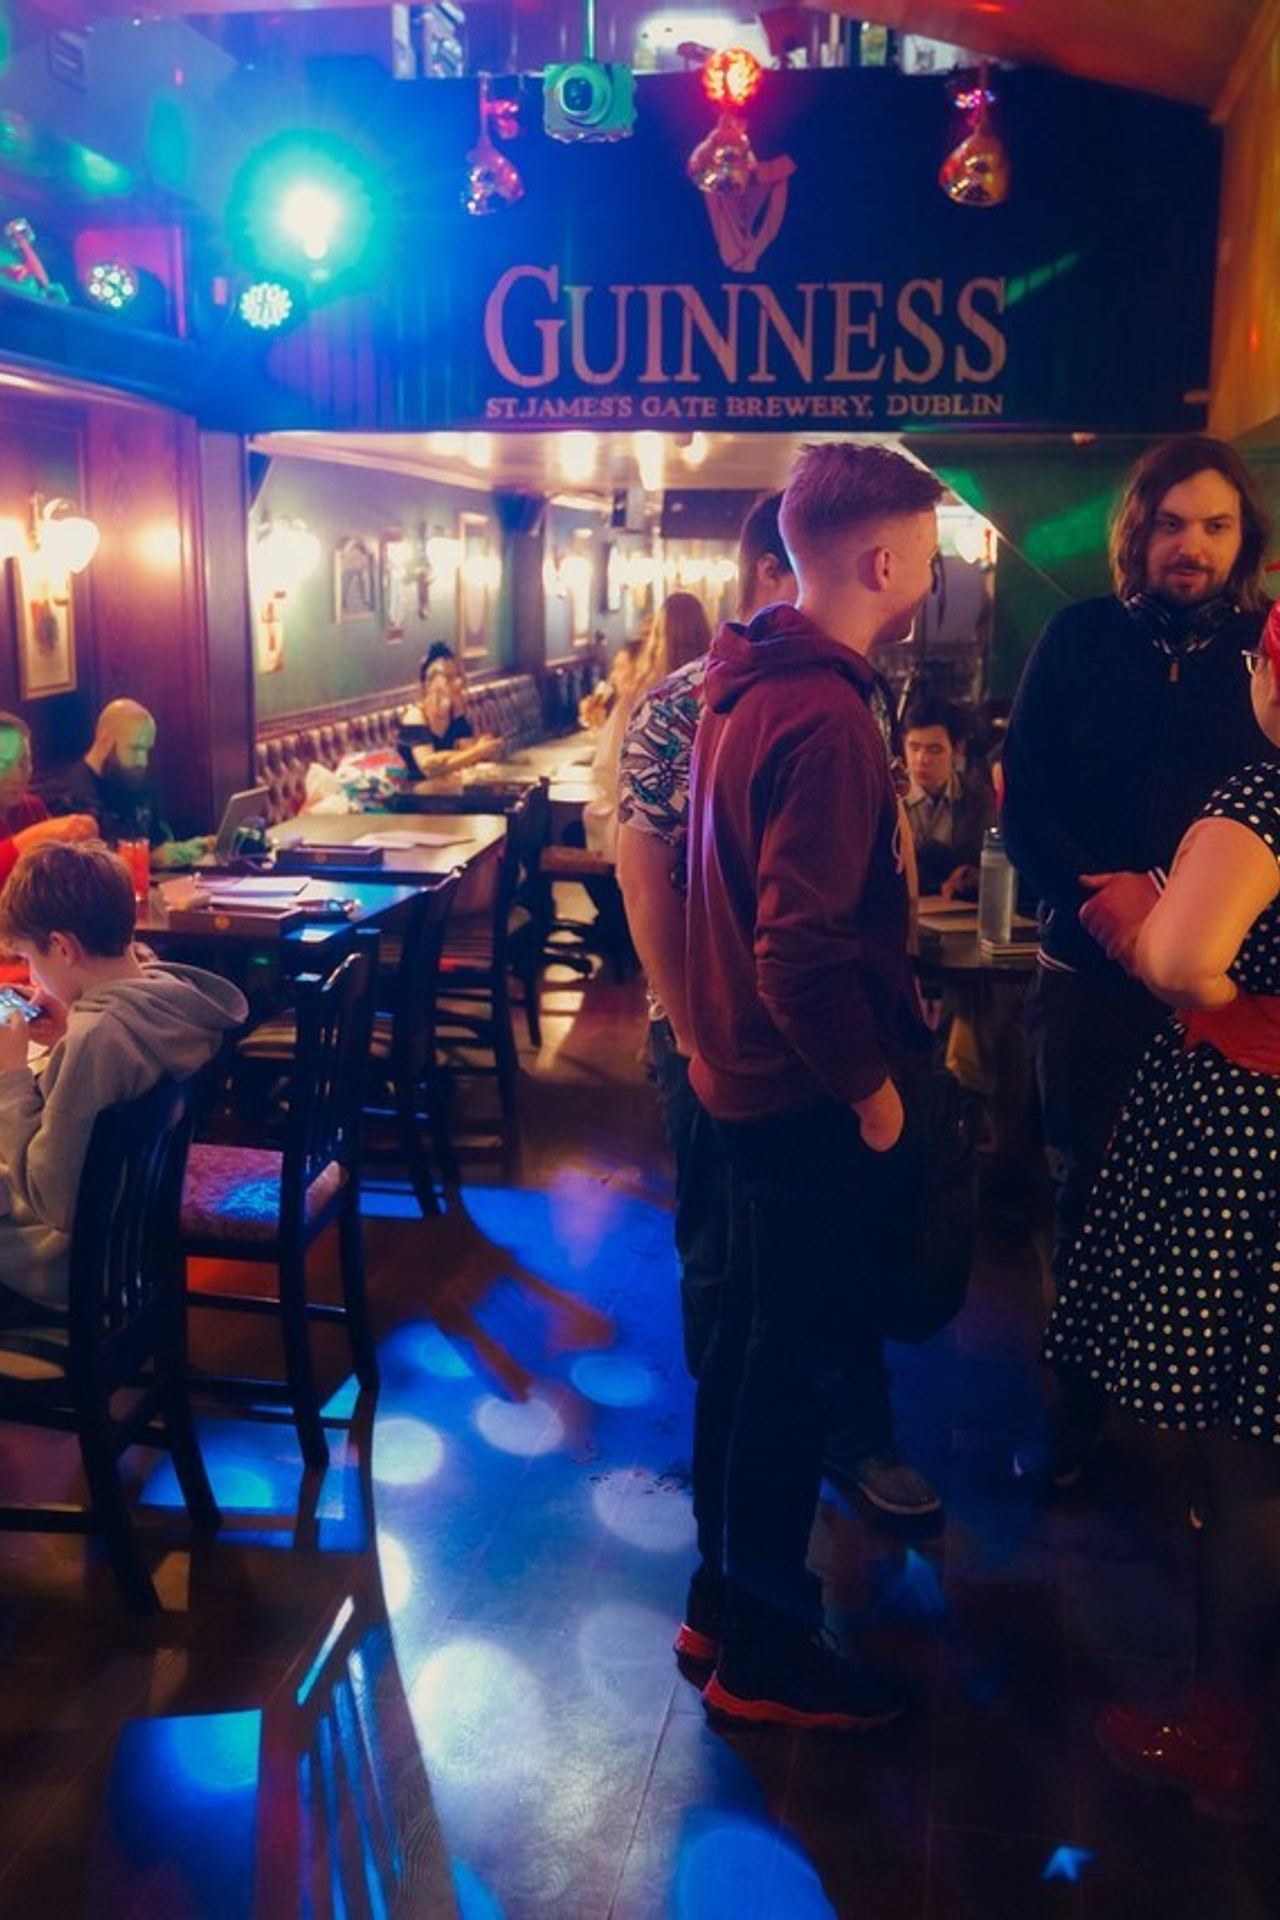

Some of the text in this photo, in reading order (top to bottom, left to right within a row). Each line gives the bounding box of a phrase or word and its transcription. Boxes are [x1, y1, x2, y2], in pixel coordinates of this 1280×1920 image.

[484, 264, 1008, 388] GUINNESS
[641, 396, 716, 418] GATE
[886, 394, 1004, 416] DUBLIN
